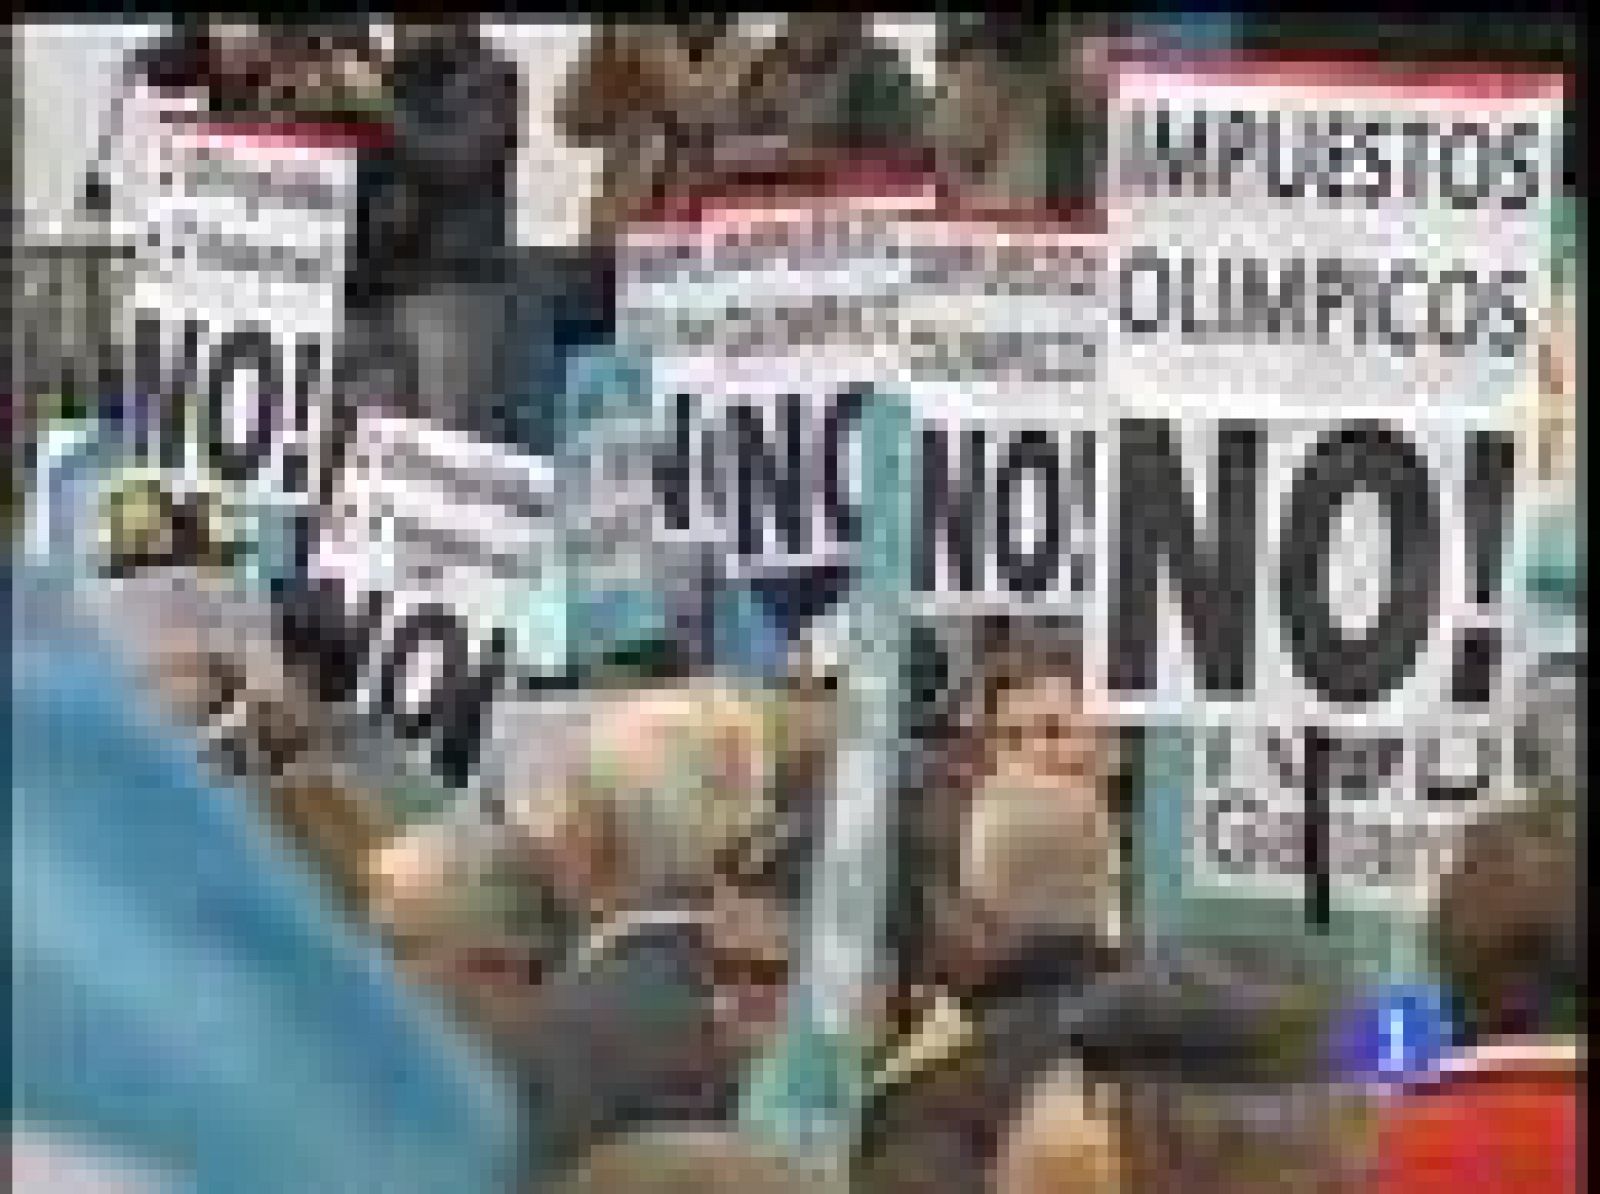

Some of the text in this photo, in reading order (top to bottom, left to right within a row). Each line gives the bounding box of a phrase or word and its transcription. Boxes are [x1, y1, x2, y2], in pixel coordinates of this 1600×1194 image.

[1126, 106, 1541, 210] IMPUESTOS
[1119, 250, 1530, 357] OLIMPICOS
[134, 316, 323, 494] NO!
[1107, 417, 1516, 702] NO!
